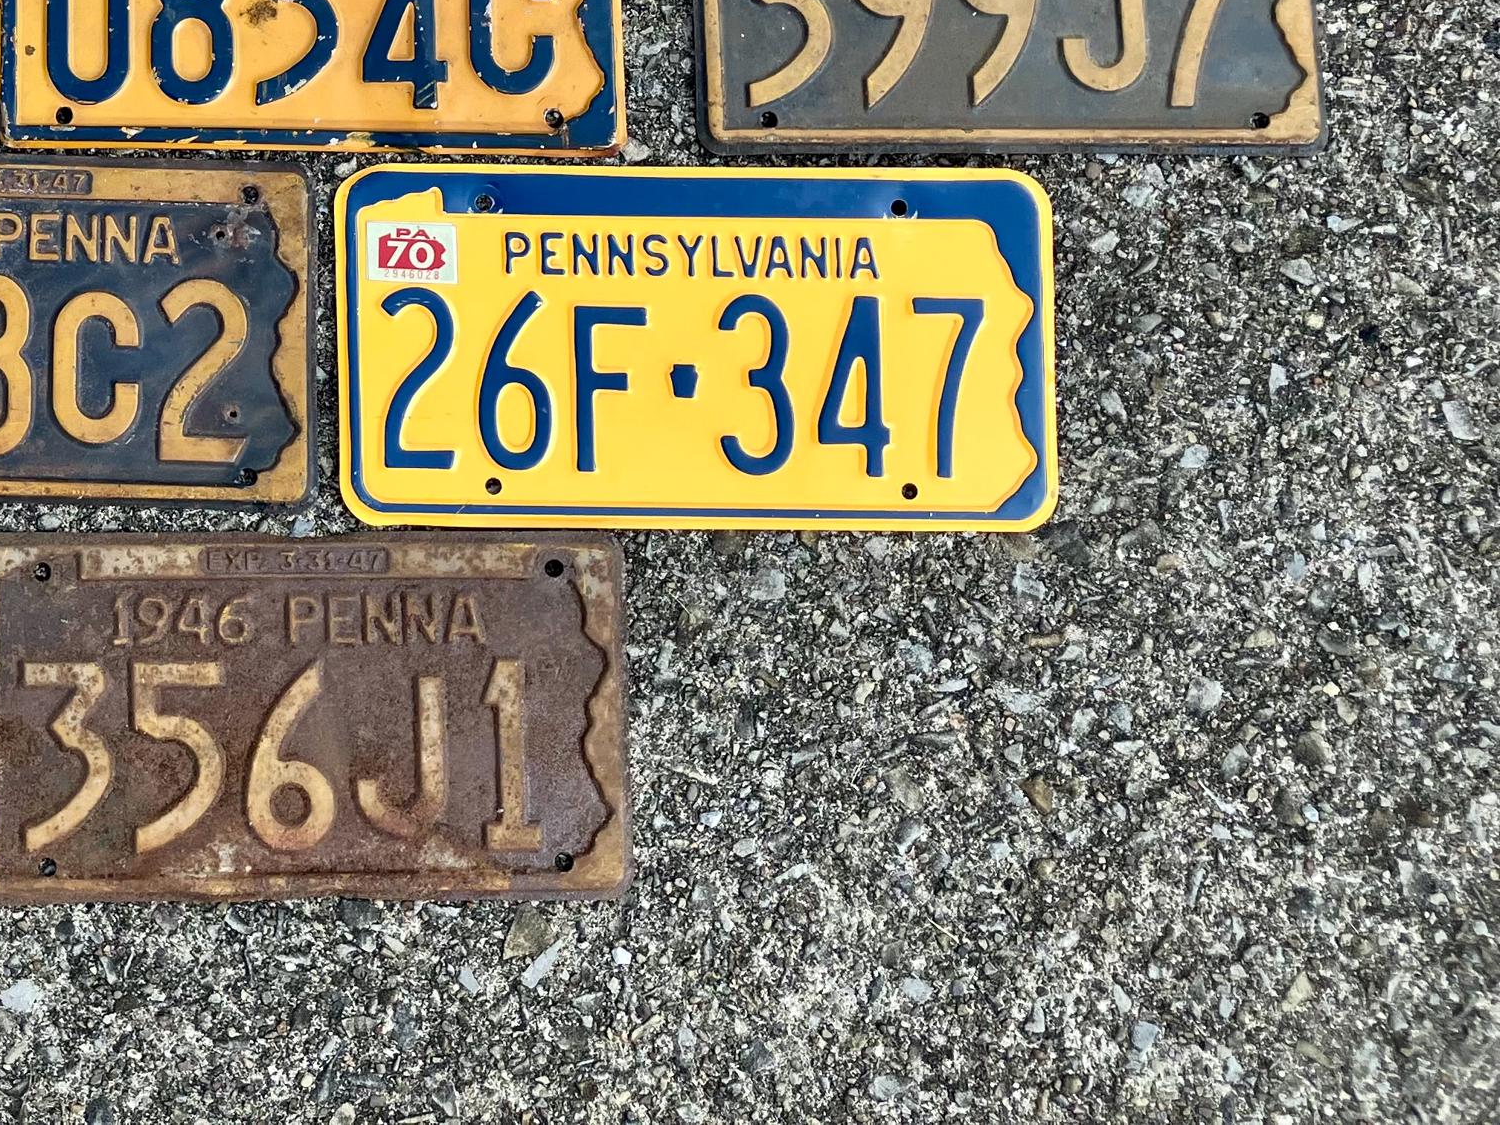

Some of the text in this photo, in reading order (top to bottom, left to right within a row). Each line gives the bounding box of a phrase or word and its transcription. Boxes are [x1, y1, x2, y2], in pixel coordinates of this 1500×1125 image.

[386, 241, 435, 269] 70
[505, 232, 878, 278] PENNSYLVANIA
[278, 549, 384, 571] 3-31-47
[113, 593, 485, 646] 1946 PENNA
[23, 658, 542, 853] 356J1
